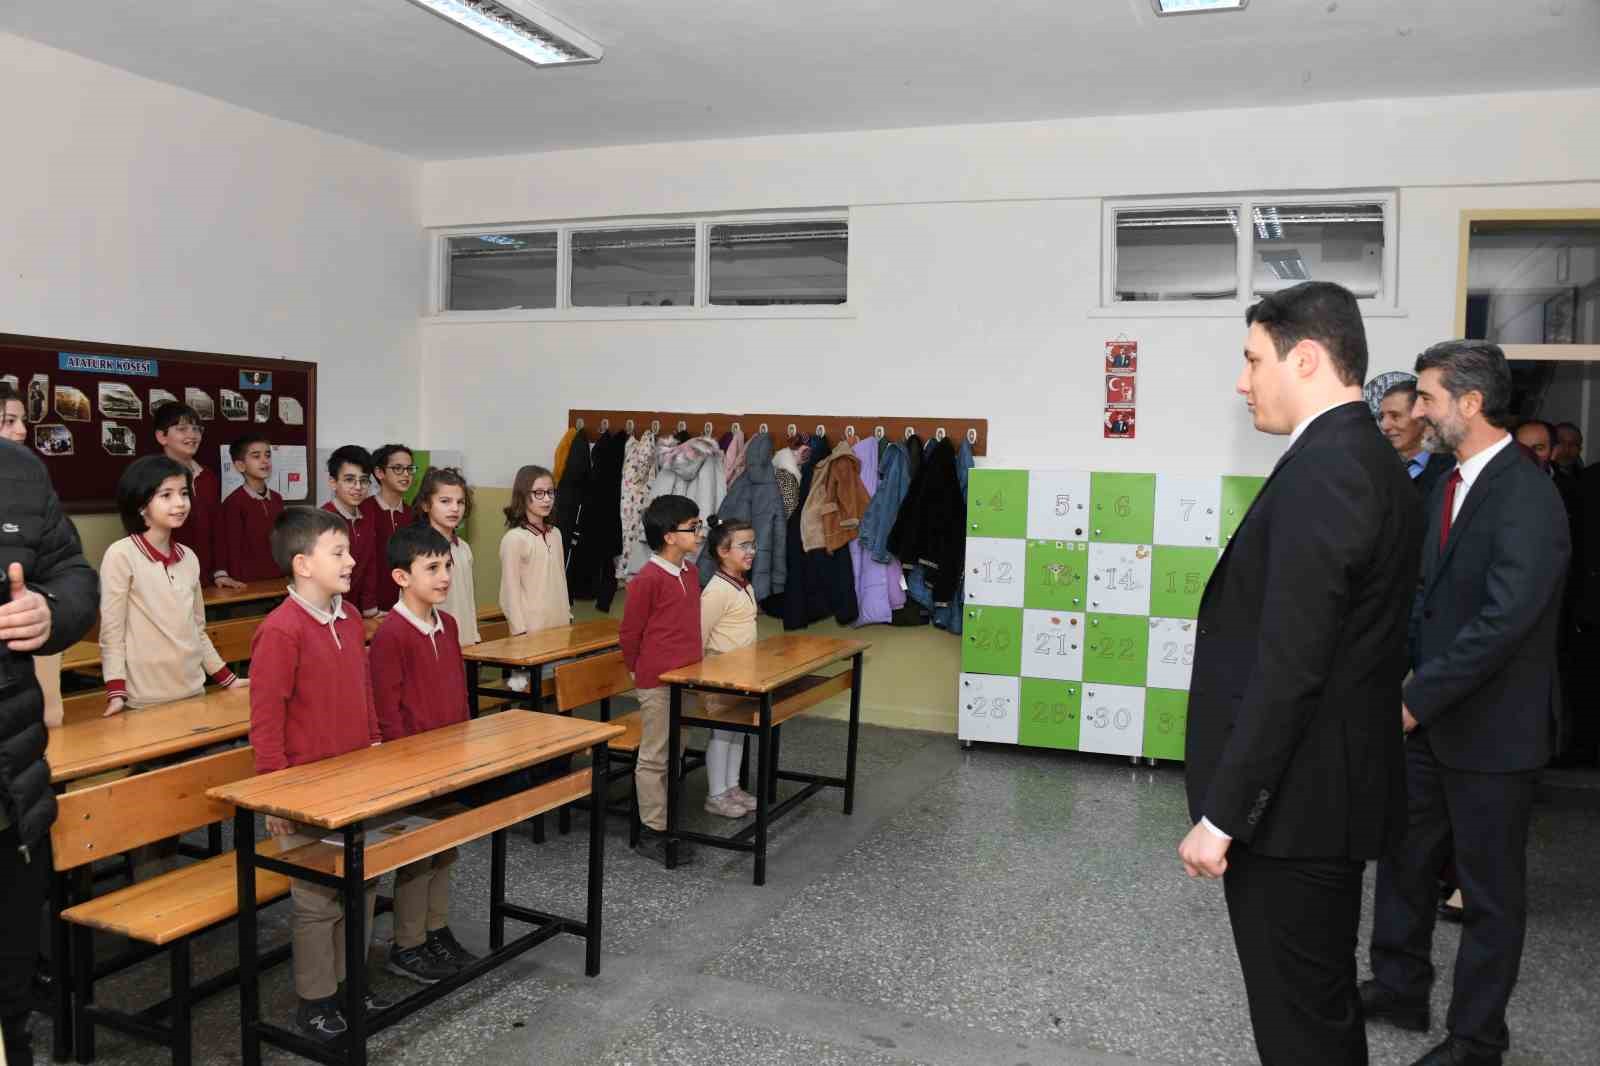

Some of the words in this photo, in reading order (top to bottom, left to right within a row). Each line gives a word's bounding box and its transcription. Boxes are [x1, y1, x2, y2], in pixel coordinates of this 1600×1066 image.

[988, 488, 1005, 512] 4
[1055, 494, 1070, 516] 5
[1114, 496, 1131, 518] 6
[1179, 498, 1197, 521] 7
[982, 559, 1013, 584] 12
[1104, 567, 1136, 591] 14
[1165, 571, 1201, 594] 15
[1034, 632, 1067, 656] 21
[1100, 636, 1136, 661] 22
[972, 696, 1008, 719] 28
[1031, 701, 1067, 724] 29
[1093, 706, 1132, 730] 30
